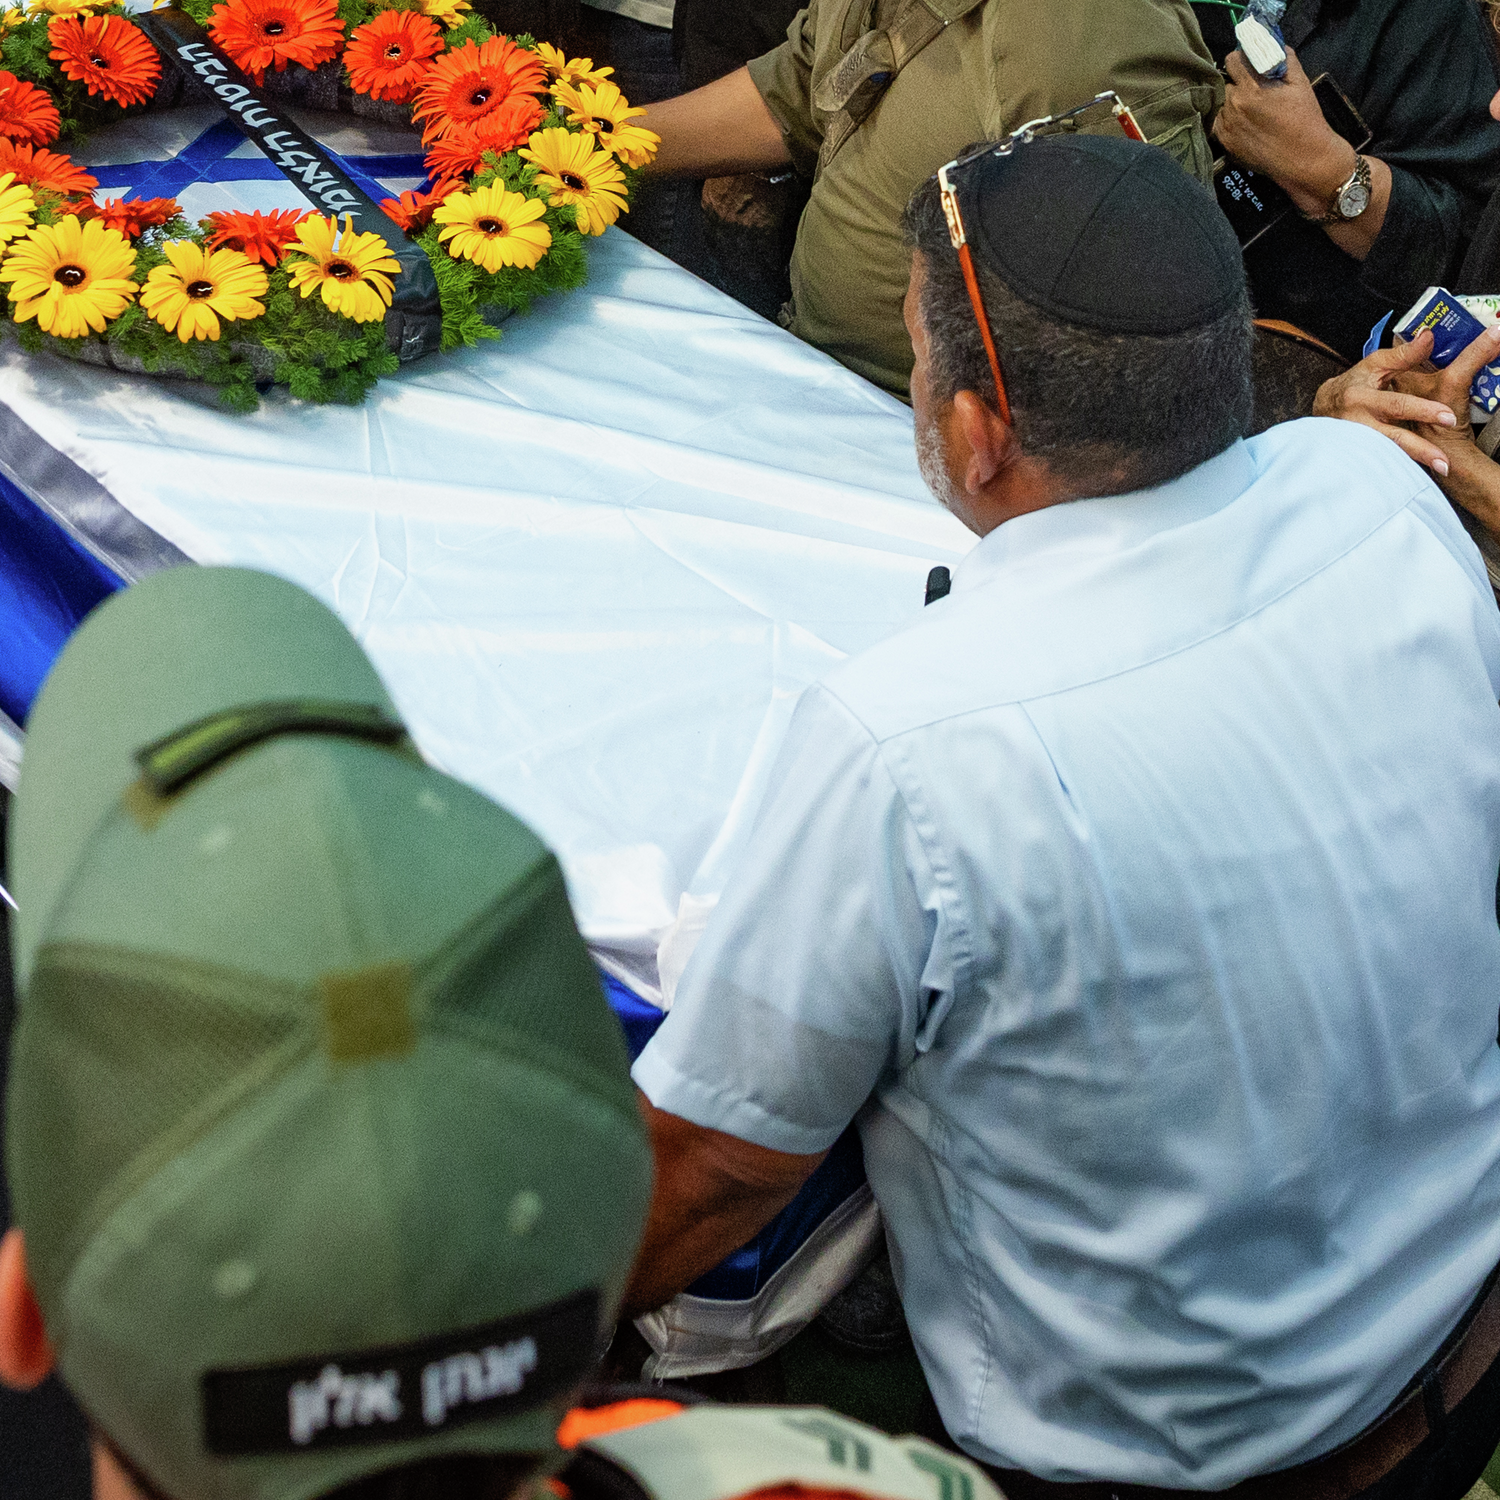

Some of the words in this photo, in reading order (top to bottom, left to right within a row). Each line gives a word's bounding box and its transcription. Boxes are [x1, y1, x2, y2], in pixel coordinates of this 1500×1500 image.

[177, 43, 279, 128] הביטוח
[263, 130, 363, 222] הלאומי
[1222, 175, 1243, 201] 18:26
[288, 1364, 403, 1445] אלון
[421, 1336, 538, 1426] יונתן
